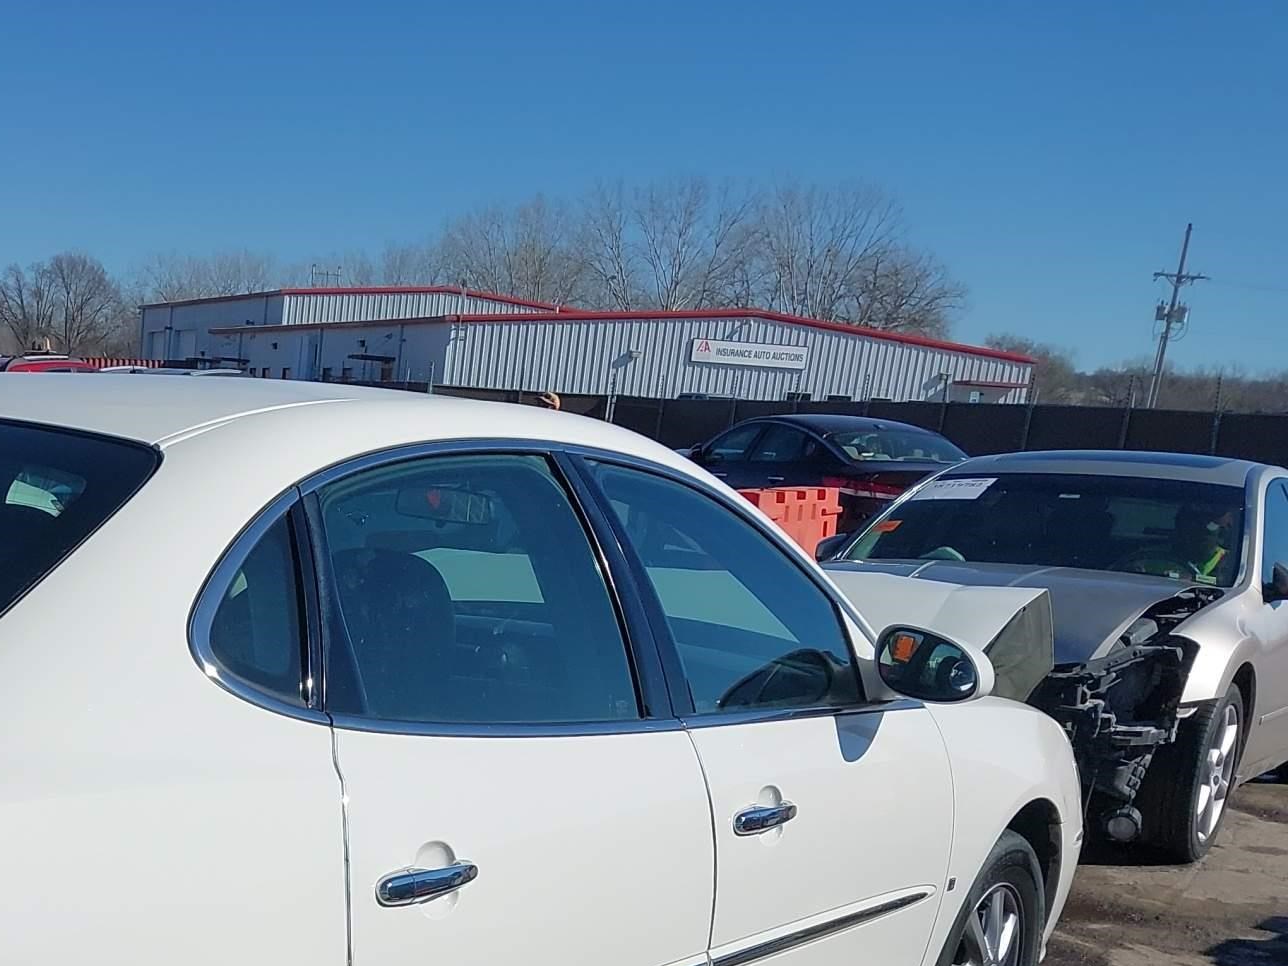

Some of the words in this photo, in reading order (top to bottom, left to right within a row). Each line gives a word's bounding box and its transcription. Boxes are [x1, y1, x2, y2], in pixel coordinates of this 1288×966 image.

[715, 347, 752, 358] INSURANCE
[753, 350, 771, 360] AUTO
[771, 352, 804, 362] AUCTIONS
